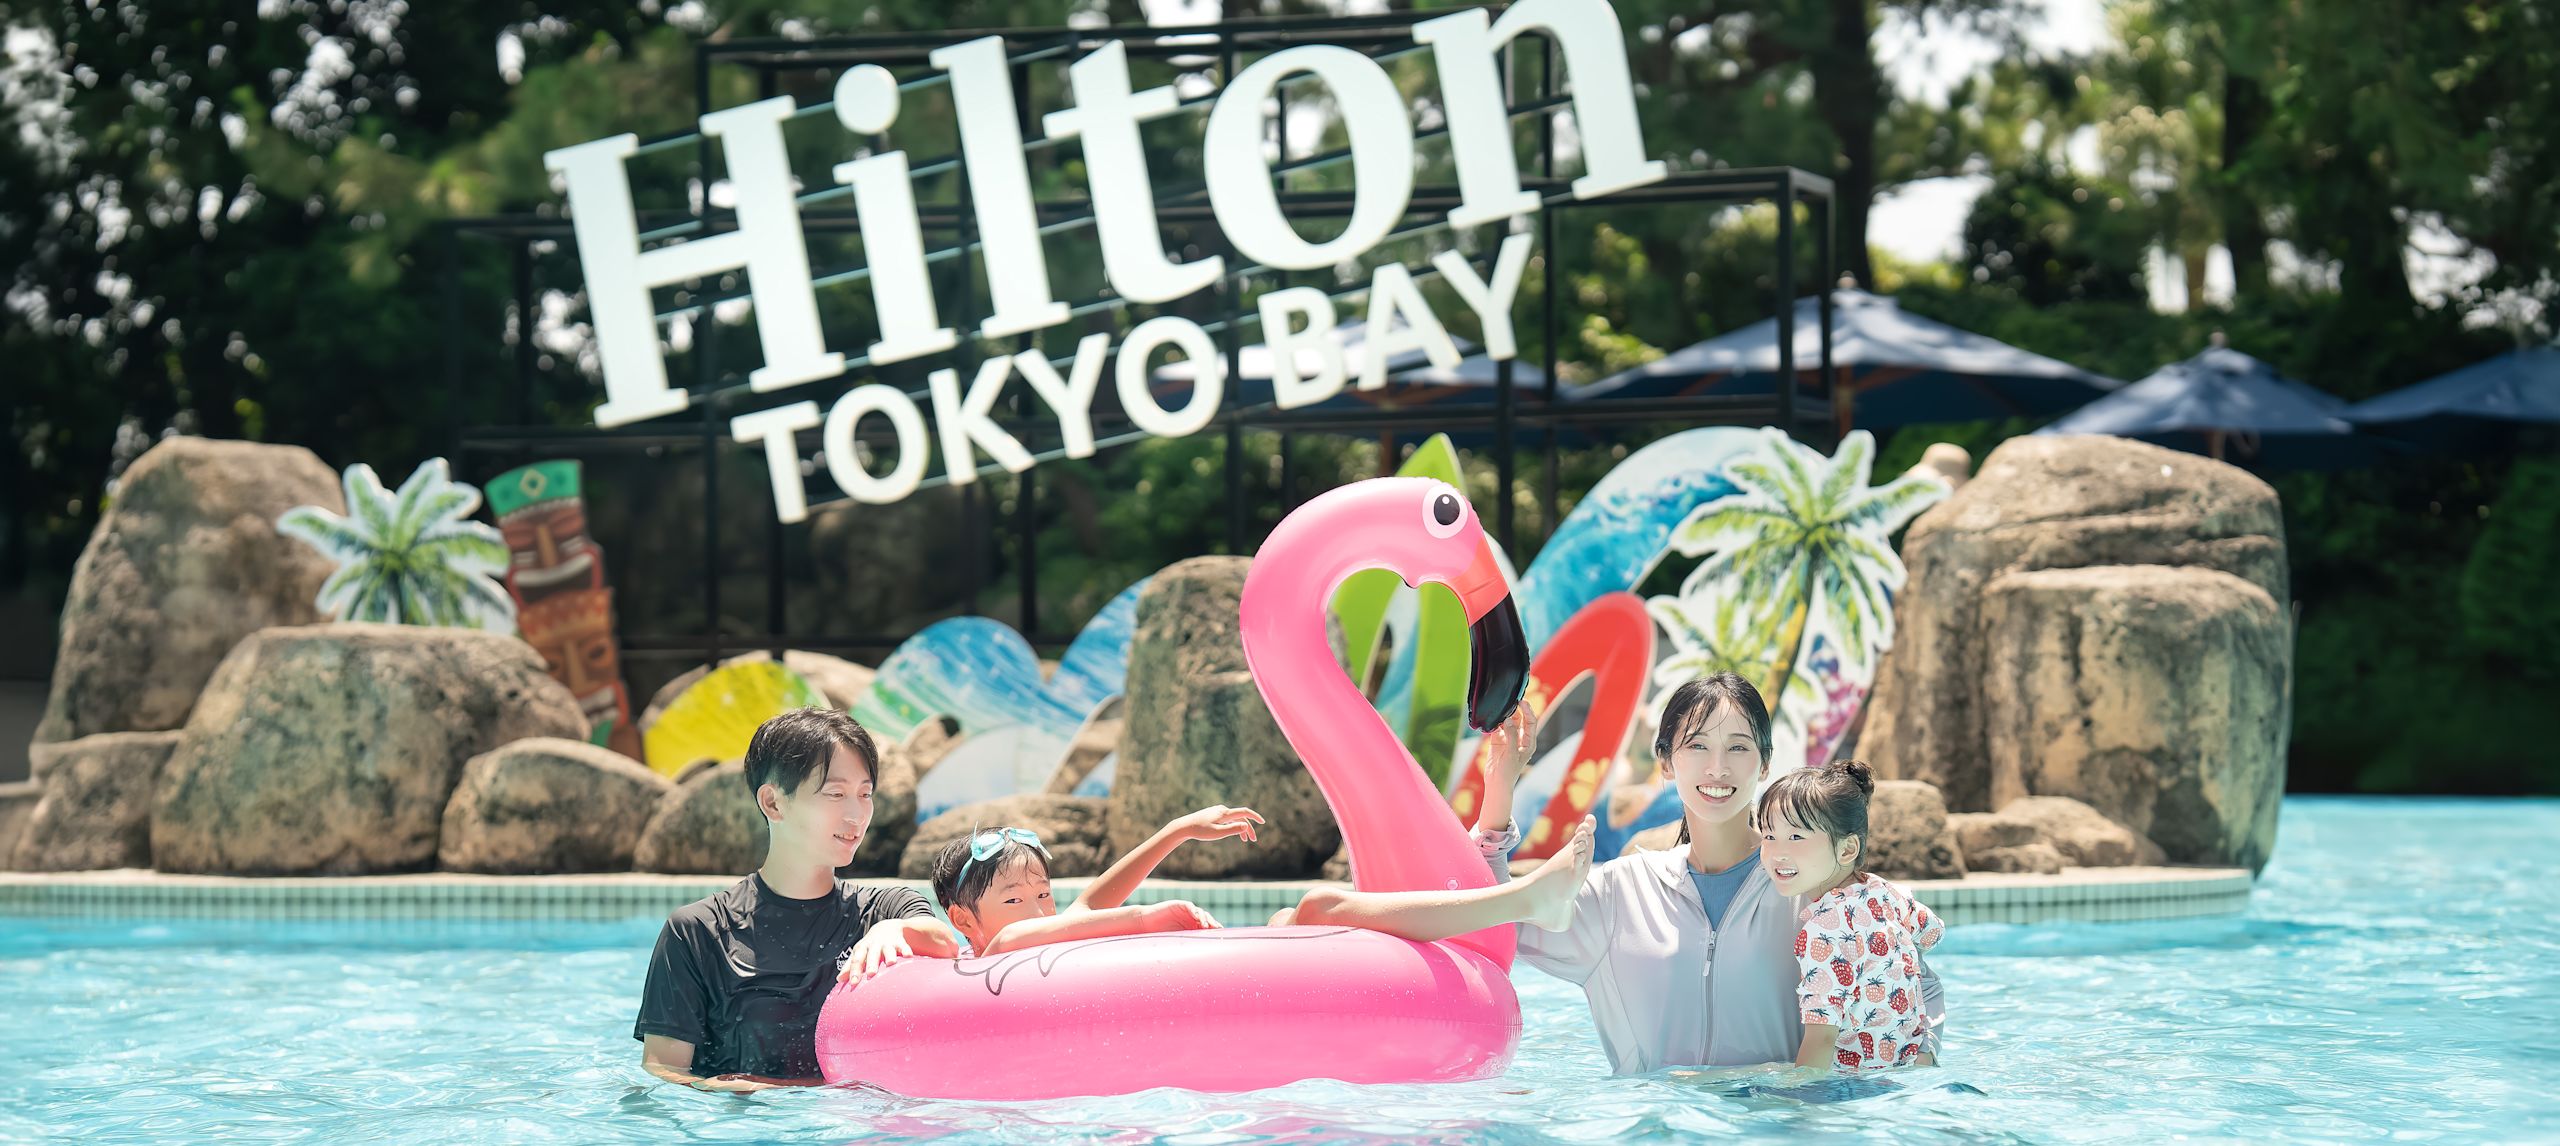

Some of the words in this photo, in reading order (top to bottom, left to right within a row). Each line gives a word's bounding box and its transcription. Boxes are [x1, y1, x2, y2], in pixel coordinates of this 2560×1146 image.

[545, 0, 1667, 427] Hilton
[732, 317, 1225, 522] TOKYO
[1258, 234, 1535, 409] BAY
